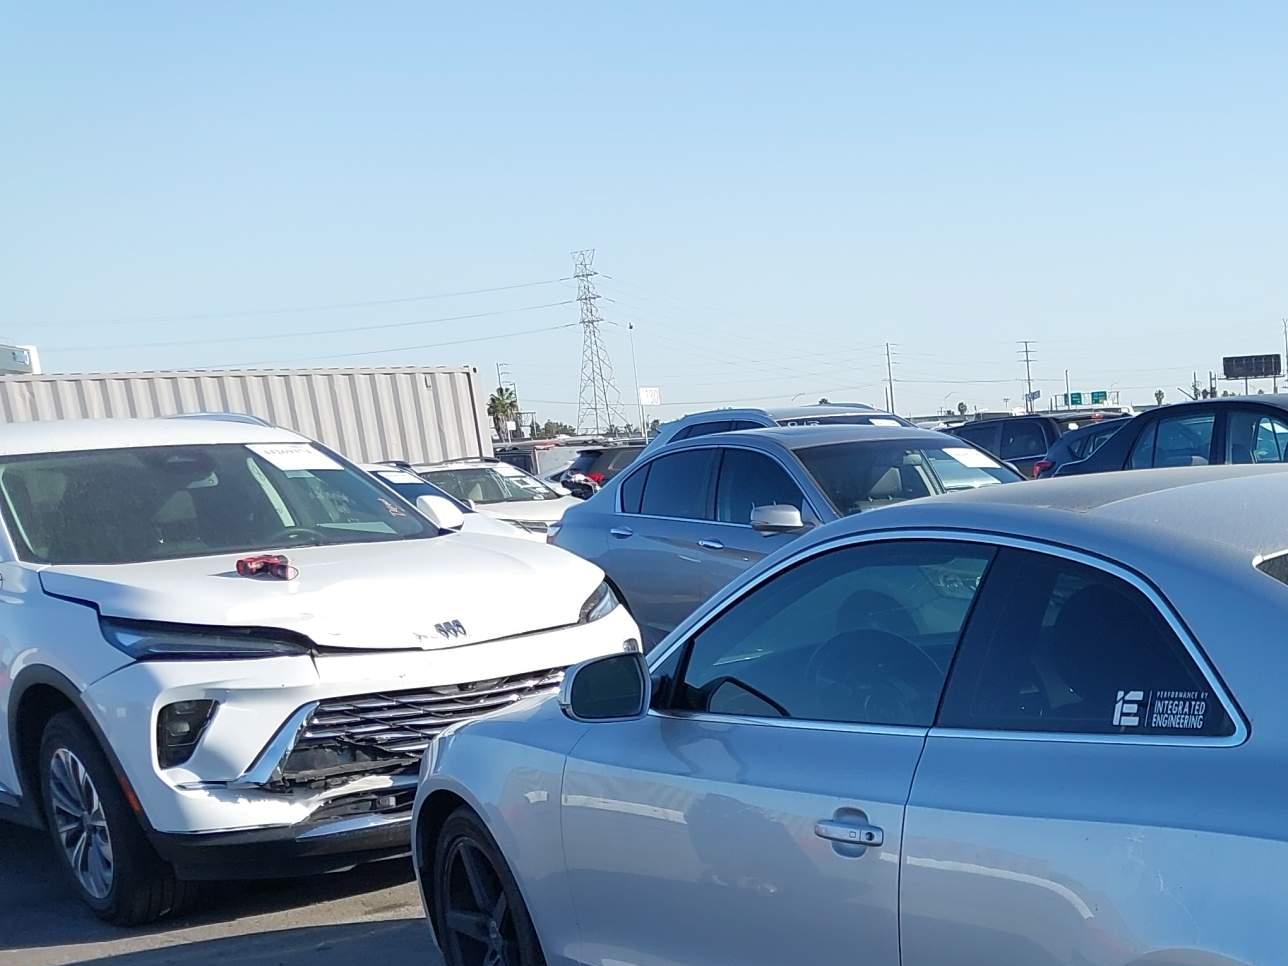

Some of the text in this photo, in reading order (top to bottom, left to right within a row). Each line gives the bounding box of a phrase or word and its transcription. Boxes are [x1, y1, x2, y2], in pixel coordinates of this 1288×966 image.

[1156, 690, 1209, 700] PERFORMANCE BY
[1154, 700, 1206, 715] INTEGRATED
[1151, 713, 1204, 729] ENGINEERING
